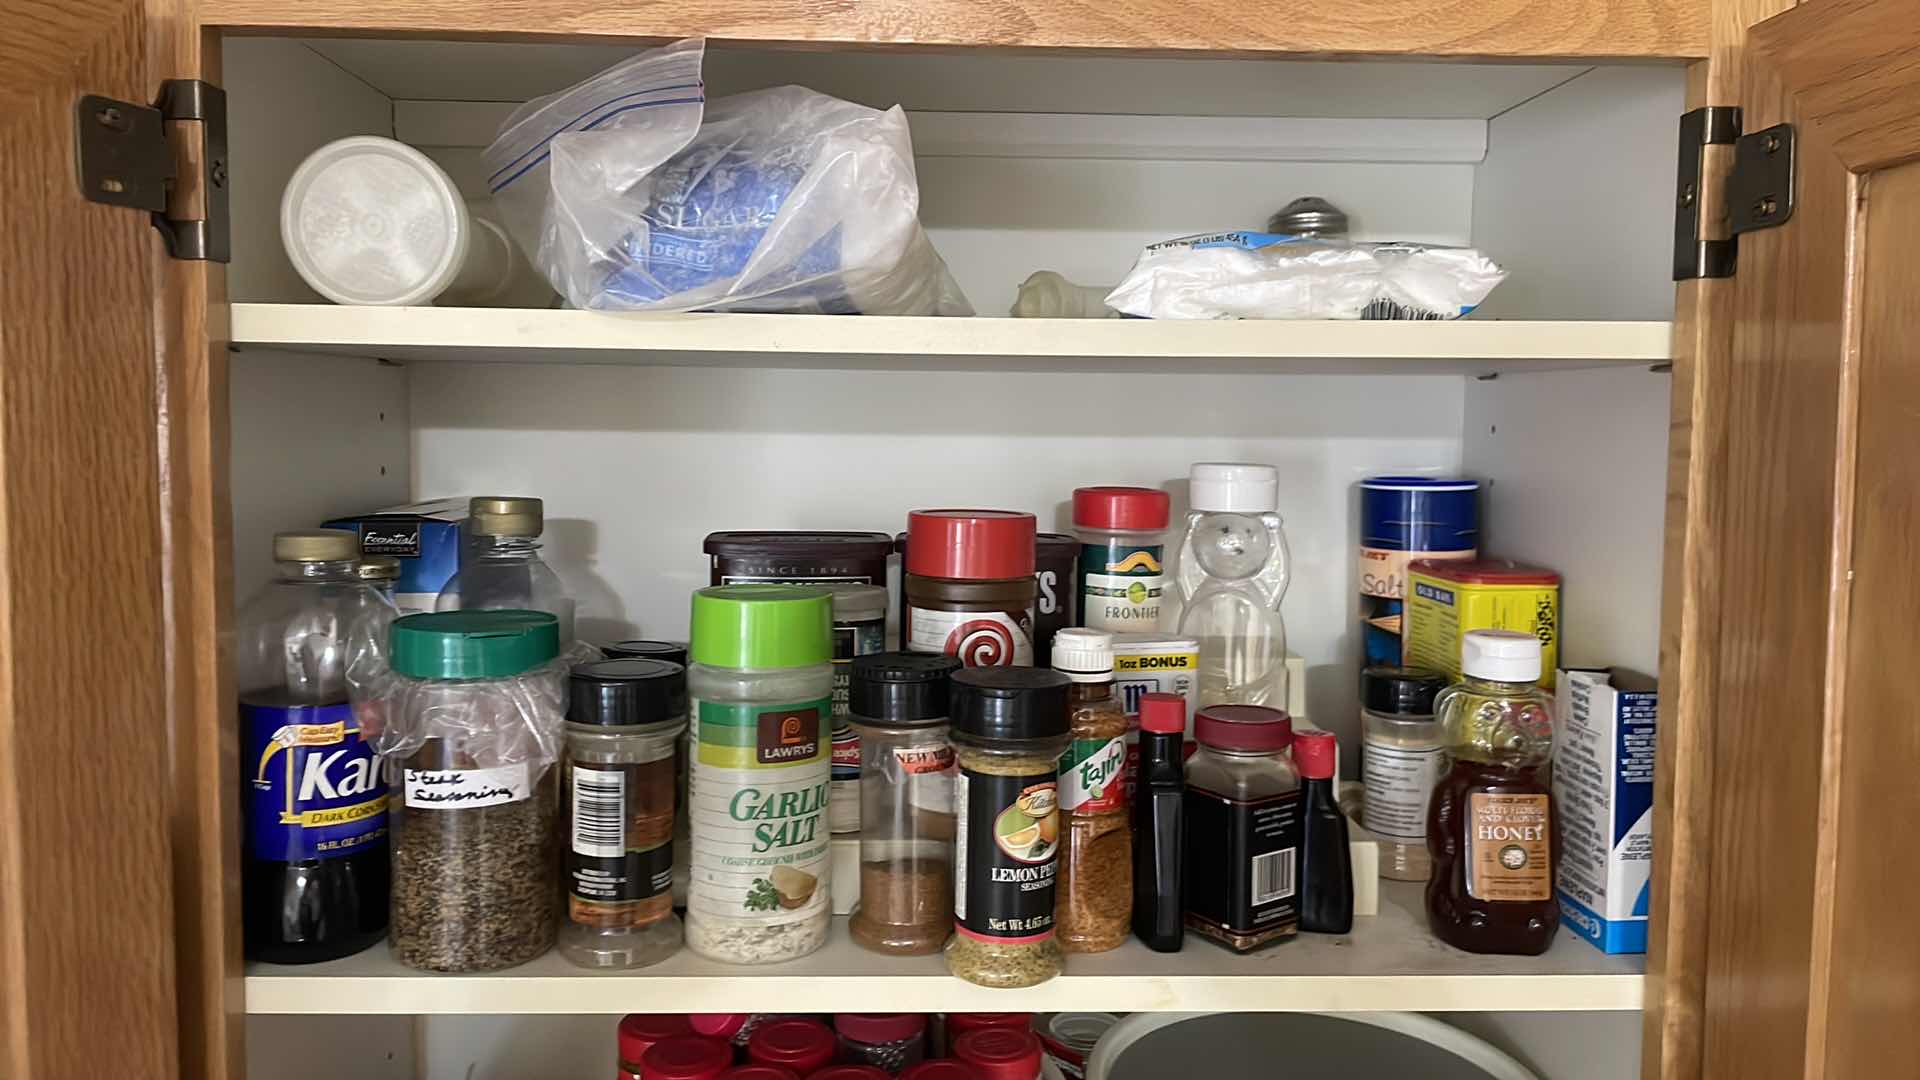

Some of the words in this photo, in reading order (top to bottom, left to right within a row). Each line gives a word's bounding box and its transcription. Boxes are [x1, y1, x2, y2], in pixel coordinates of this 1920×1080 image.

[364, 532, 417, 545] Essential
[747, 567, 800, 575] SINCE
[810, 567, 848, 575] 1894
[1363, 574, 1404, 597] Salt
[1104, 606, 1160, 619] FRONTIER
[1139, 656, 1188, 668] BONUS
[298, 749, 383, 800] Kar
[752, 815, 820, 853] SALT
[1479, 824, 1544, 840] HONEY
[991, 867, 1039, 882] LEMON
[988, 918, 1007, 930] Net
[1009, 919, 1023, 930] Wt
